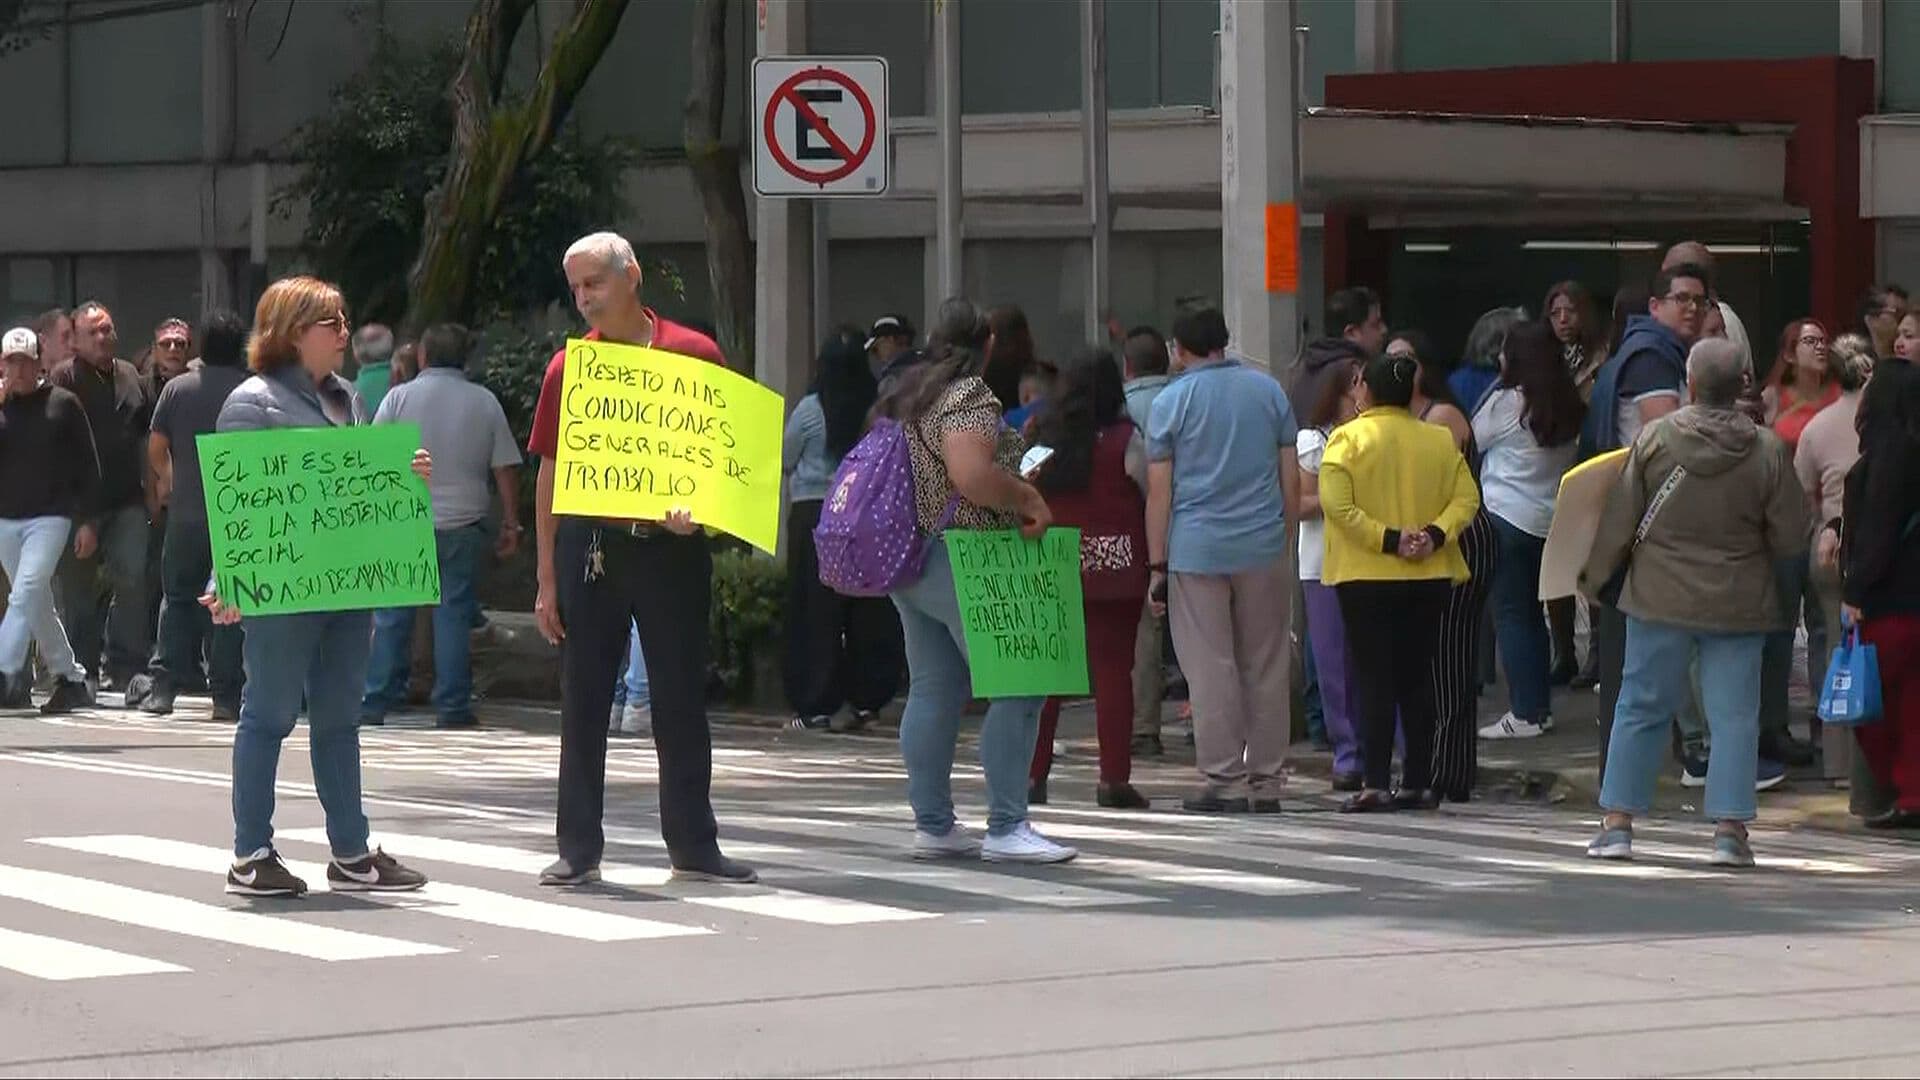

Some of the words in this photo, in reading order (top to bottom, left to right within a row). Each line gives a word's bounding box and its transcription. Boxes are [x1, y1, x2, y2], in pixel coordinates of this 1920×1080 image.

[572, 345, 664, 392] RESPETO
[567, 383, 736, 448] CONDICIONES
[301, 451, 336, 474] ES
[343, 450, 371, 469] EL
[565, 420, 714, 469] GENERALES
[723, 456, 751, 486] DE
[319, 470, 412, 501] RECTOR
[563, 461, 696, 496] TRABAJO
[225, 519, 253, 541] DE
[269, 511, 296, 538] LA
[311, 496, 428, 534] ASISTENCIA
[224, 542, 304, 568] SOCIAL
[296, 574, 321, 600] SU
